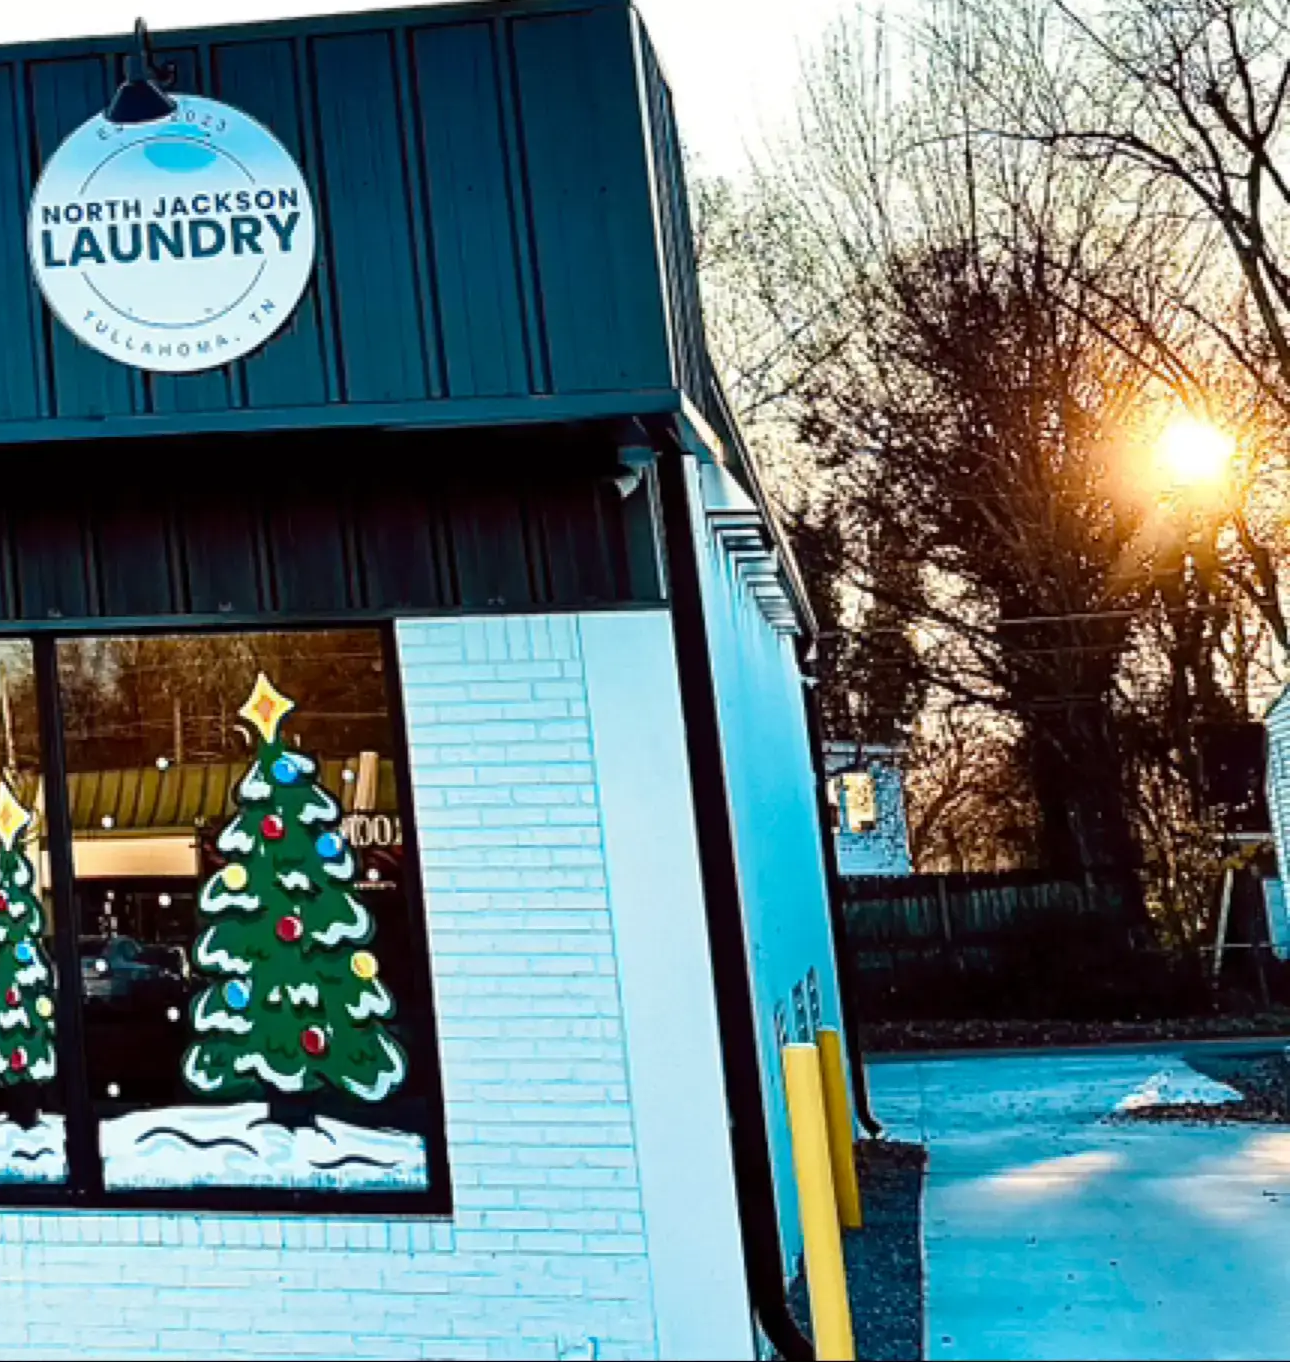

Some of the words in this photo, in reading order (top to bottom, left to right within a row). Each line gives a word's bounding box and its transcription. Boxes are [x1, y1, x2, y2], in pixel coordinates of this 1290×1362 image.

[40, 199, 142, 225] NORTH
[152, 187, 299, 219] JACKSON
[40, 211, 301, 268] LAUNDRY
